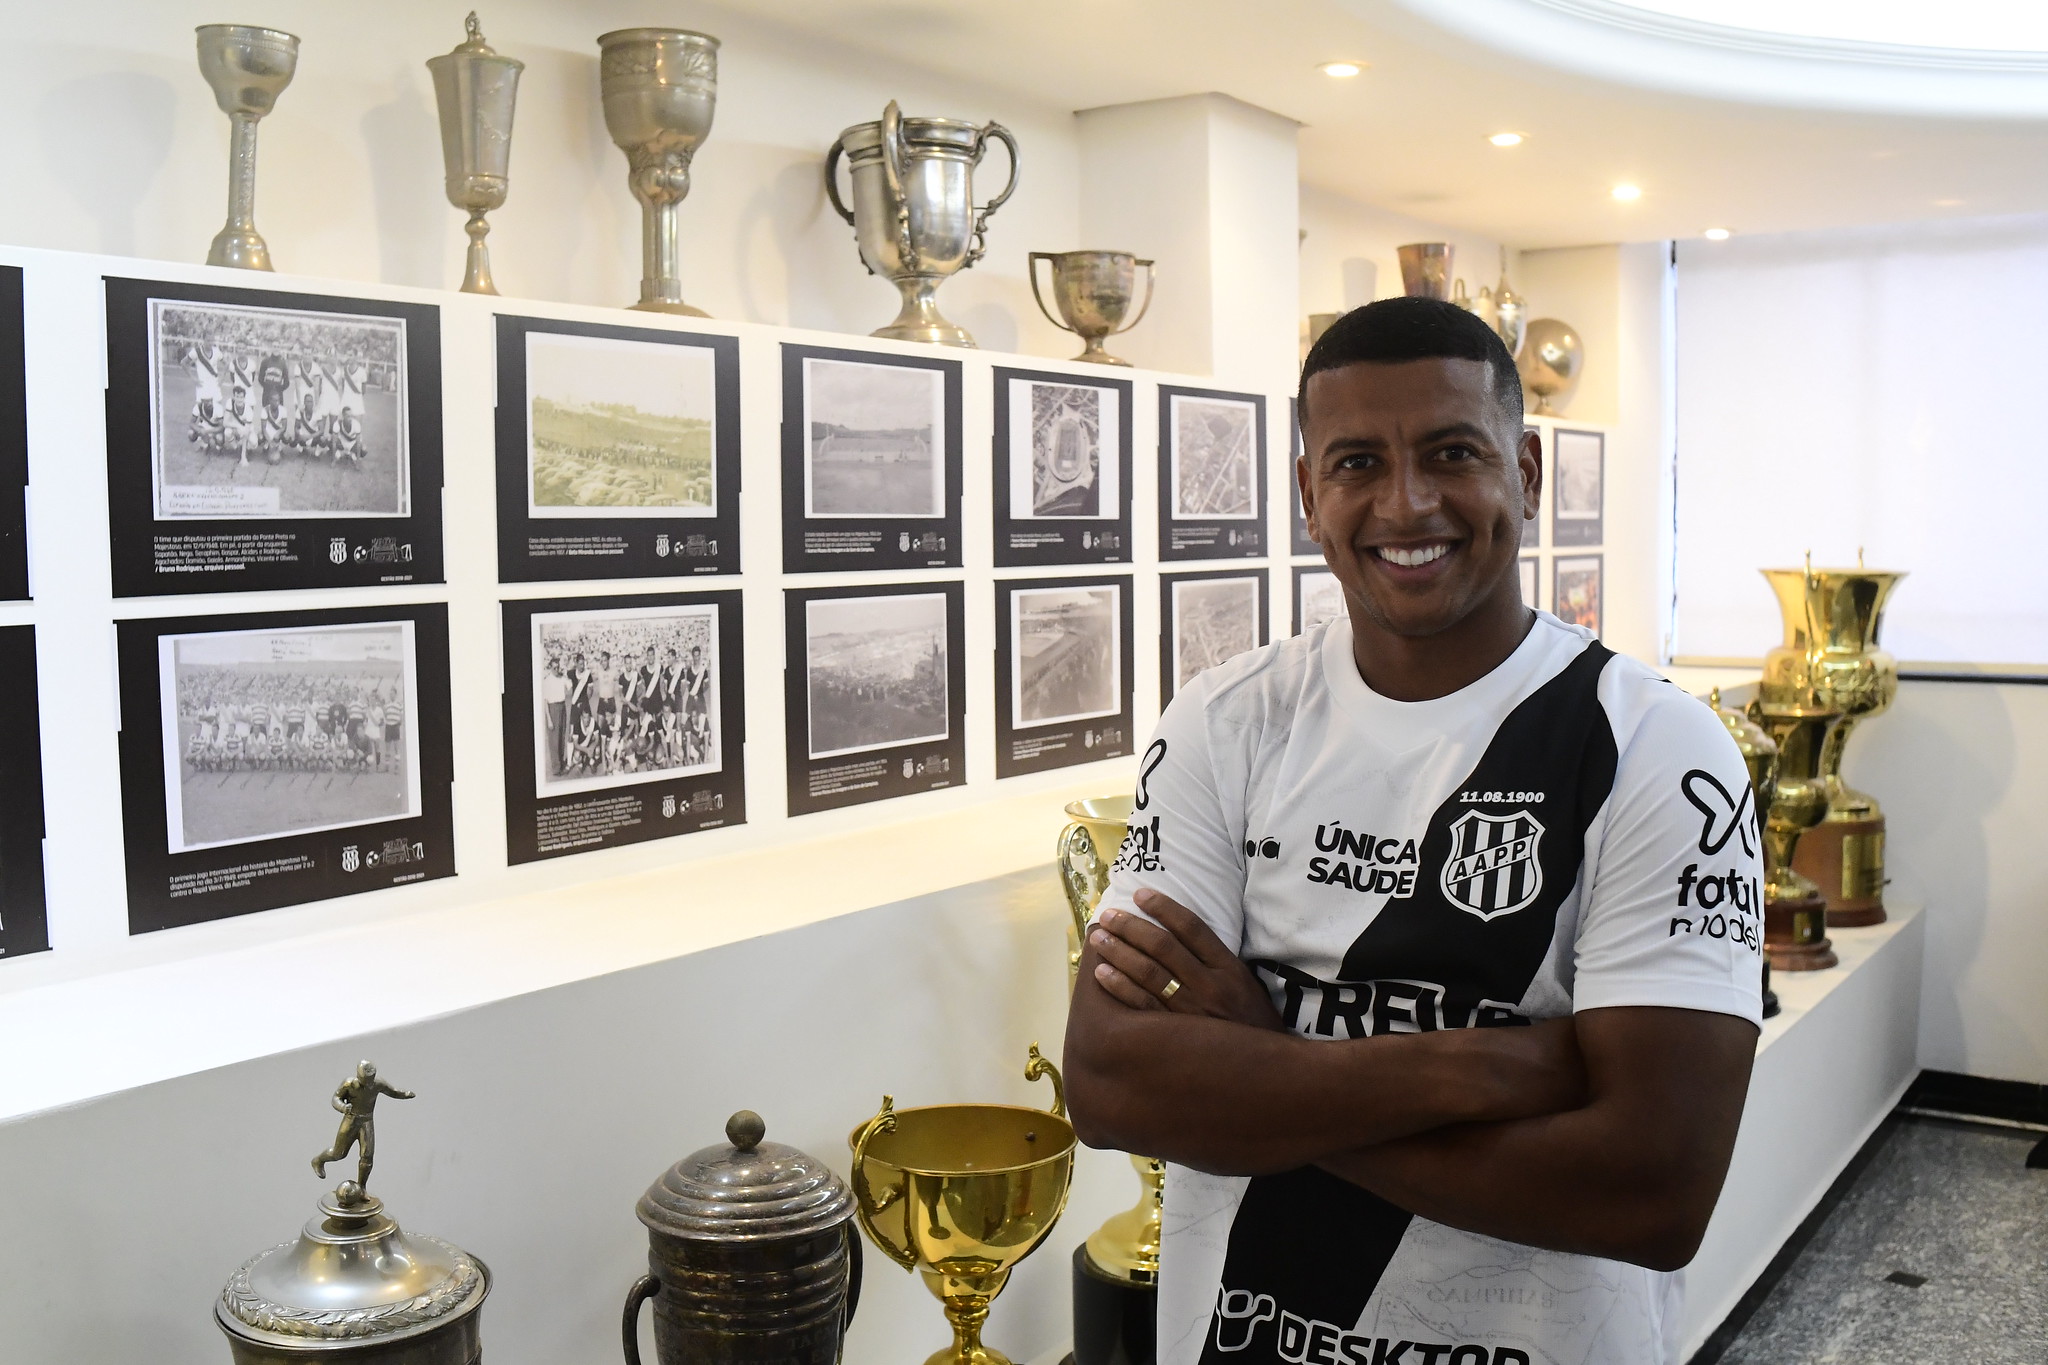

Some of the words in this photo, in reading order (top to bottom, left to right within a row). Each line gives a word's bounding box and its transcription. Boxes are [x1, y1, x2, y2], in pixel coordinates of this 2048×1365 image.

[1459, 791, 1545, 803] 11.08.1900
[1314, 820, 1417, 865] ÚNICA
[1307, 857, 1415, 895] SAÚDE
[1677, 863, 1760, 921] fatal
